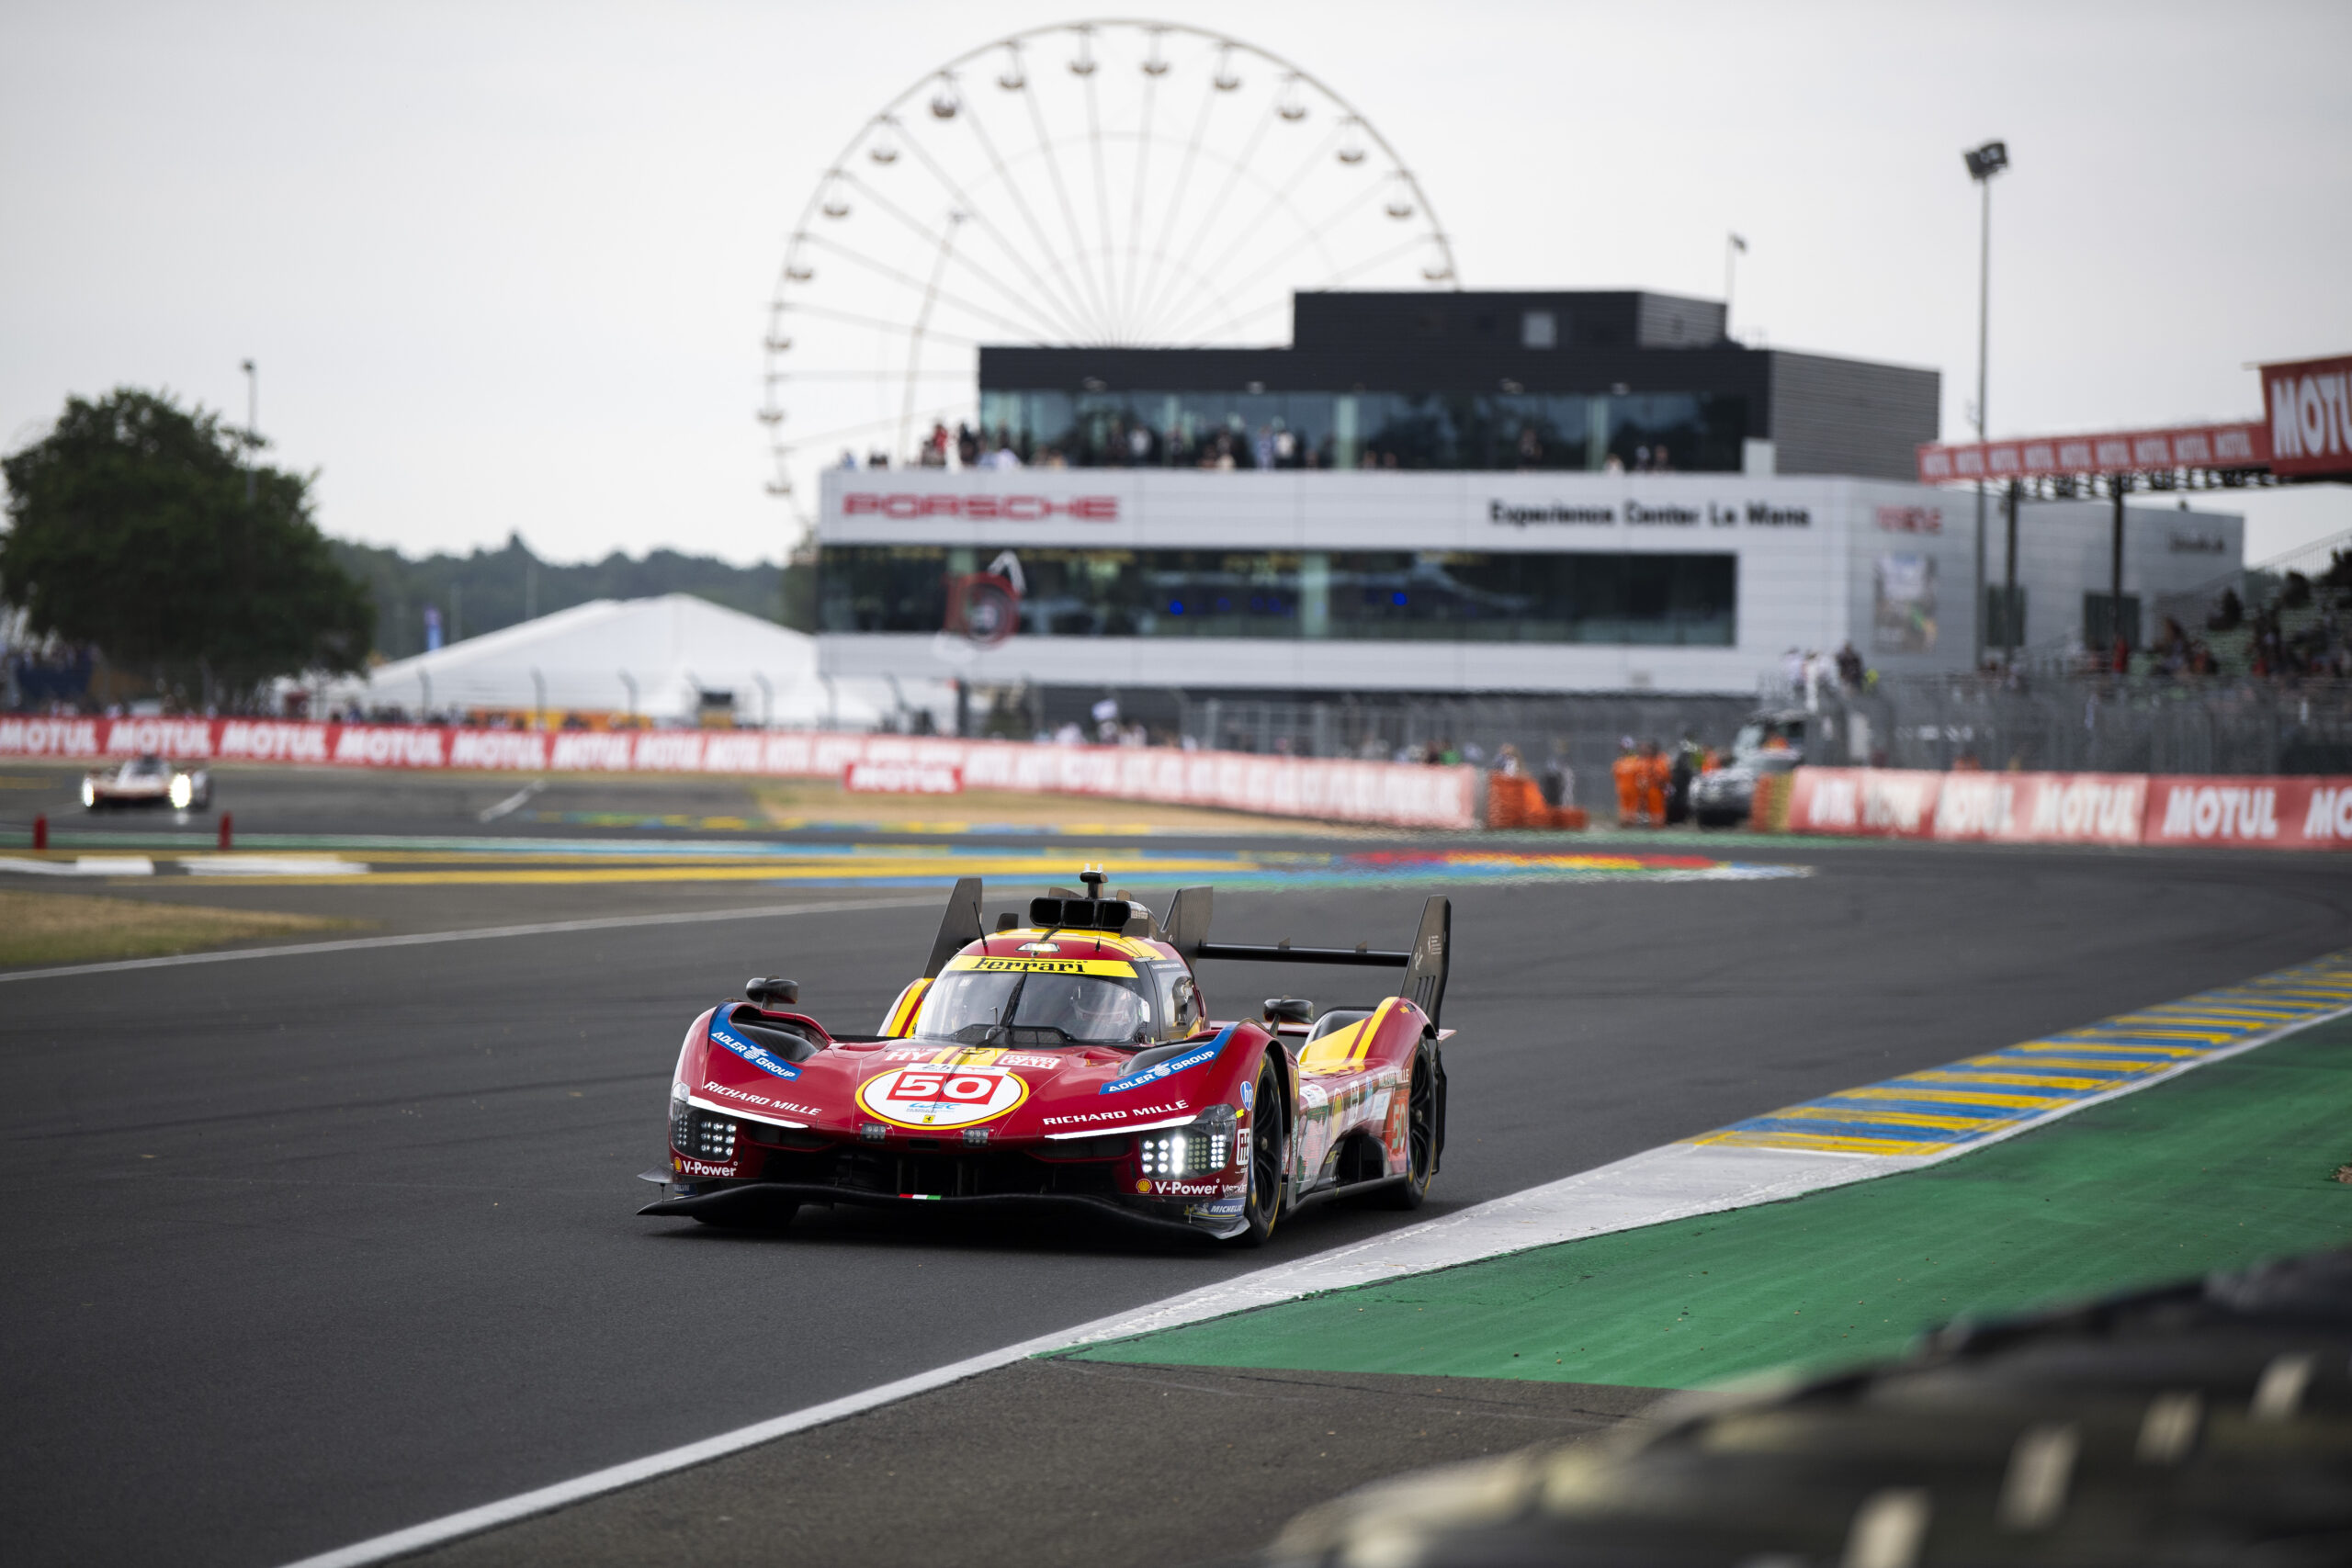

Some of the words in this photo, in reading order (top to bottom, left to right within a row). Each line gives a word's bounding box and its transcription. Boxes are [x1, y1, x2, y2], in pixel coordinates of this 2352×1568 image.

[842, 493, 1119, 523] PORSCHE
[1488, 498, 1615, 530] Experience
[1623, 498, 1700, 527] Center
[1708, 499, 1737, 527] Le
[1745, 499, 1811, 527] Mans
[107, 718, 213, 757] MOTUL
[220, 720, 327, 759] MOTUL
[334, 726, 443, 766] MOTUL
[2030, 784, 2135, 838] MOTUL
[2161, 785, 2278, 840] MOTUL
[970, 957, 1087, 973] Ferrari
[711, 1032, 747, 1053] ADLER
[755, 1057, 796, 1077] GROUP
[1108, 1073, 1155, 1092] ADLER
[1170, 1051, 1215, 1070] GROUP
[703, 1081, 770, 1105] RICHARD
[770, 1100, 821, 1116] MILLE
[894, 1074, 992, 1100] 50
[1043, 1111, 1127, 1125] RICHARD
[1132, 1100, 1189, 1117] MILLE
[683, 1160, 737, 1177] V-Power
[1155, 1181, 1218, 1195] V-Power
